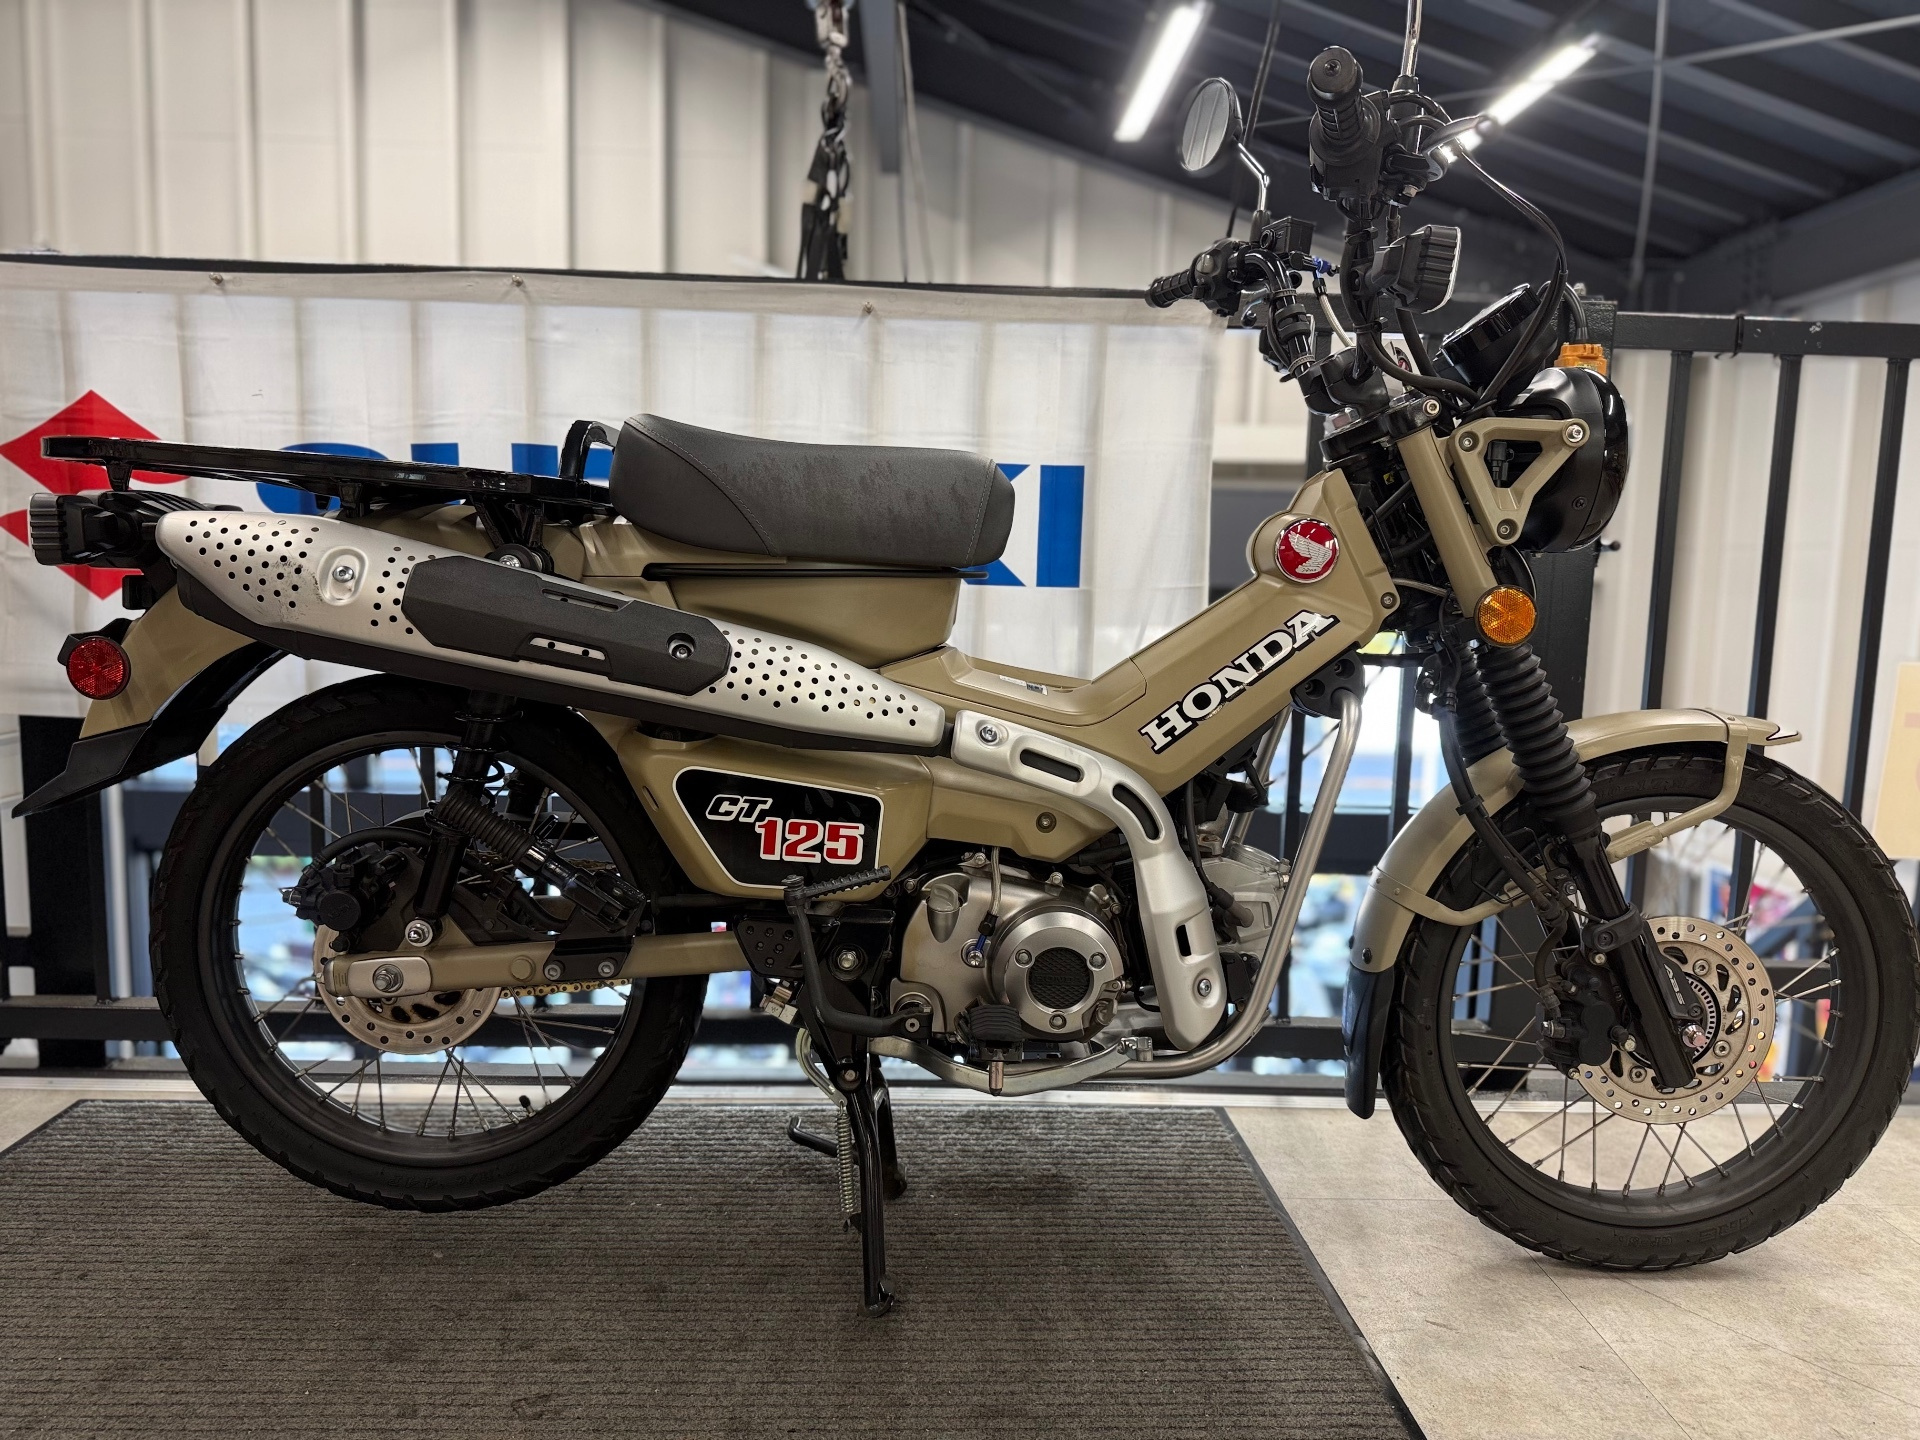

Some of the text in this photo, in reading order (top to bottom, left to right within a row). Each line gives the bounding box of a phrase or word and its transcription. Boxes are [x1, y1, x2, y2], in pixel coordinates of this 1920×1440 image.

[1139, 610, 1339, 753] HONDA
[706, 794, 865, 865] CT 125
[1663, 963, 1685, 1005] ABS
